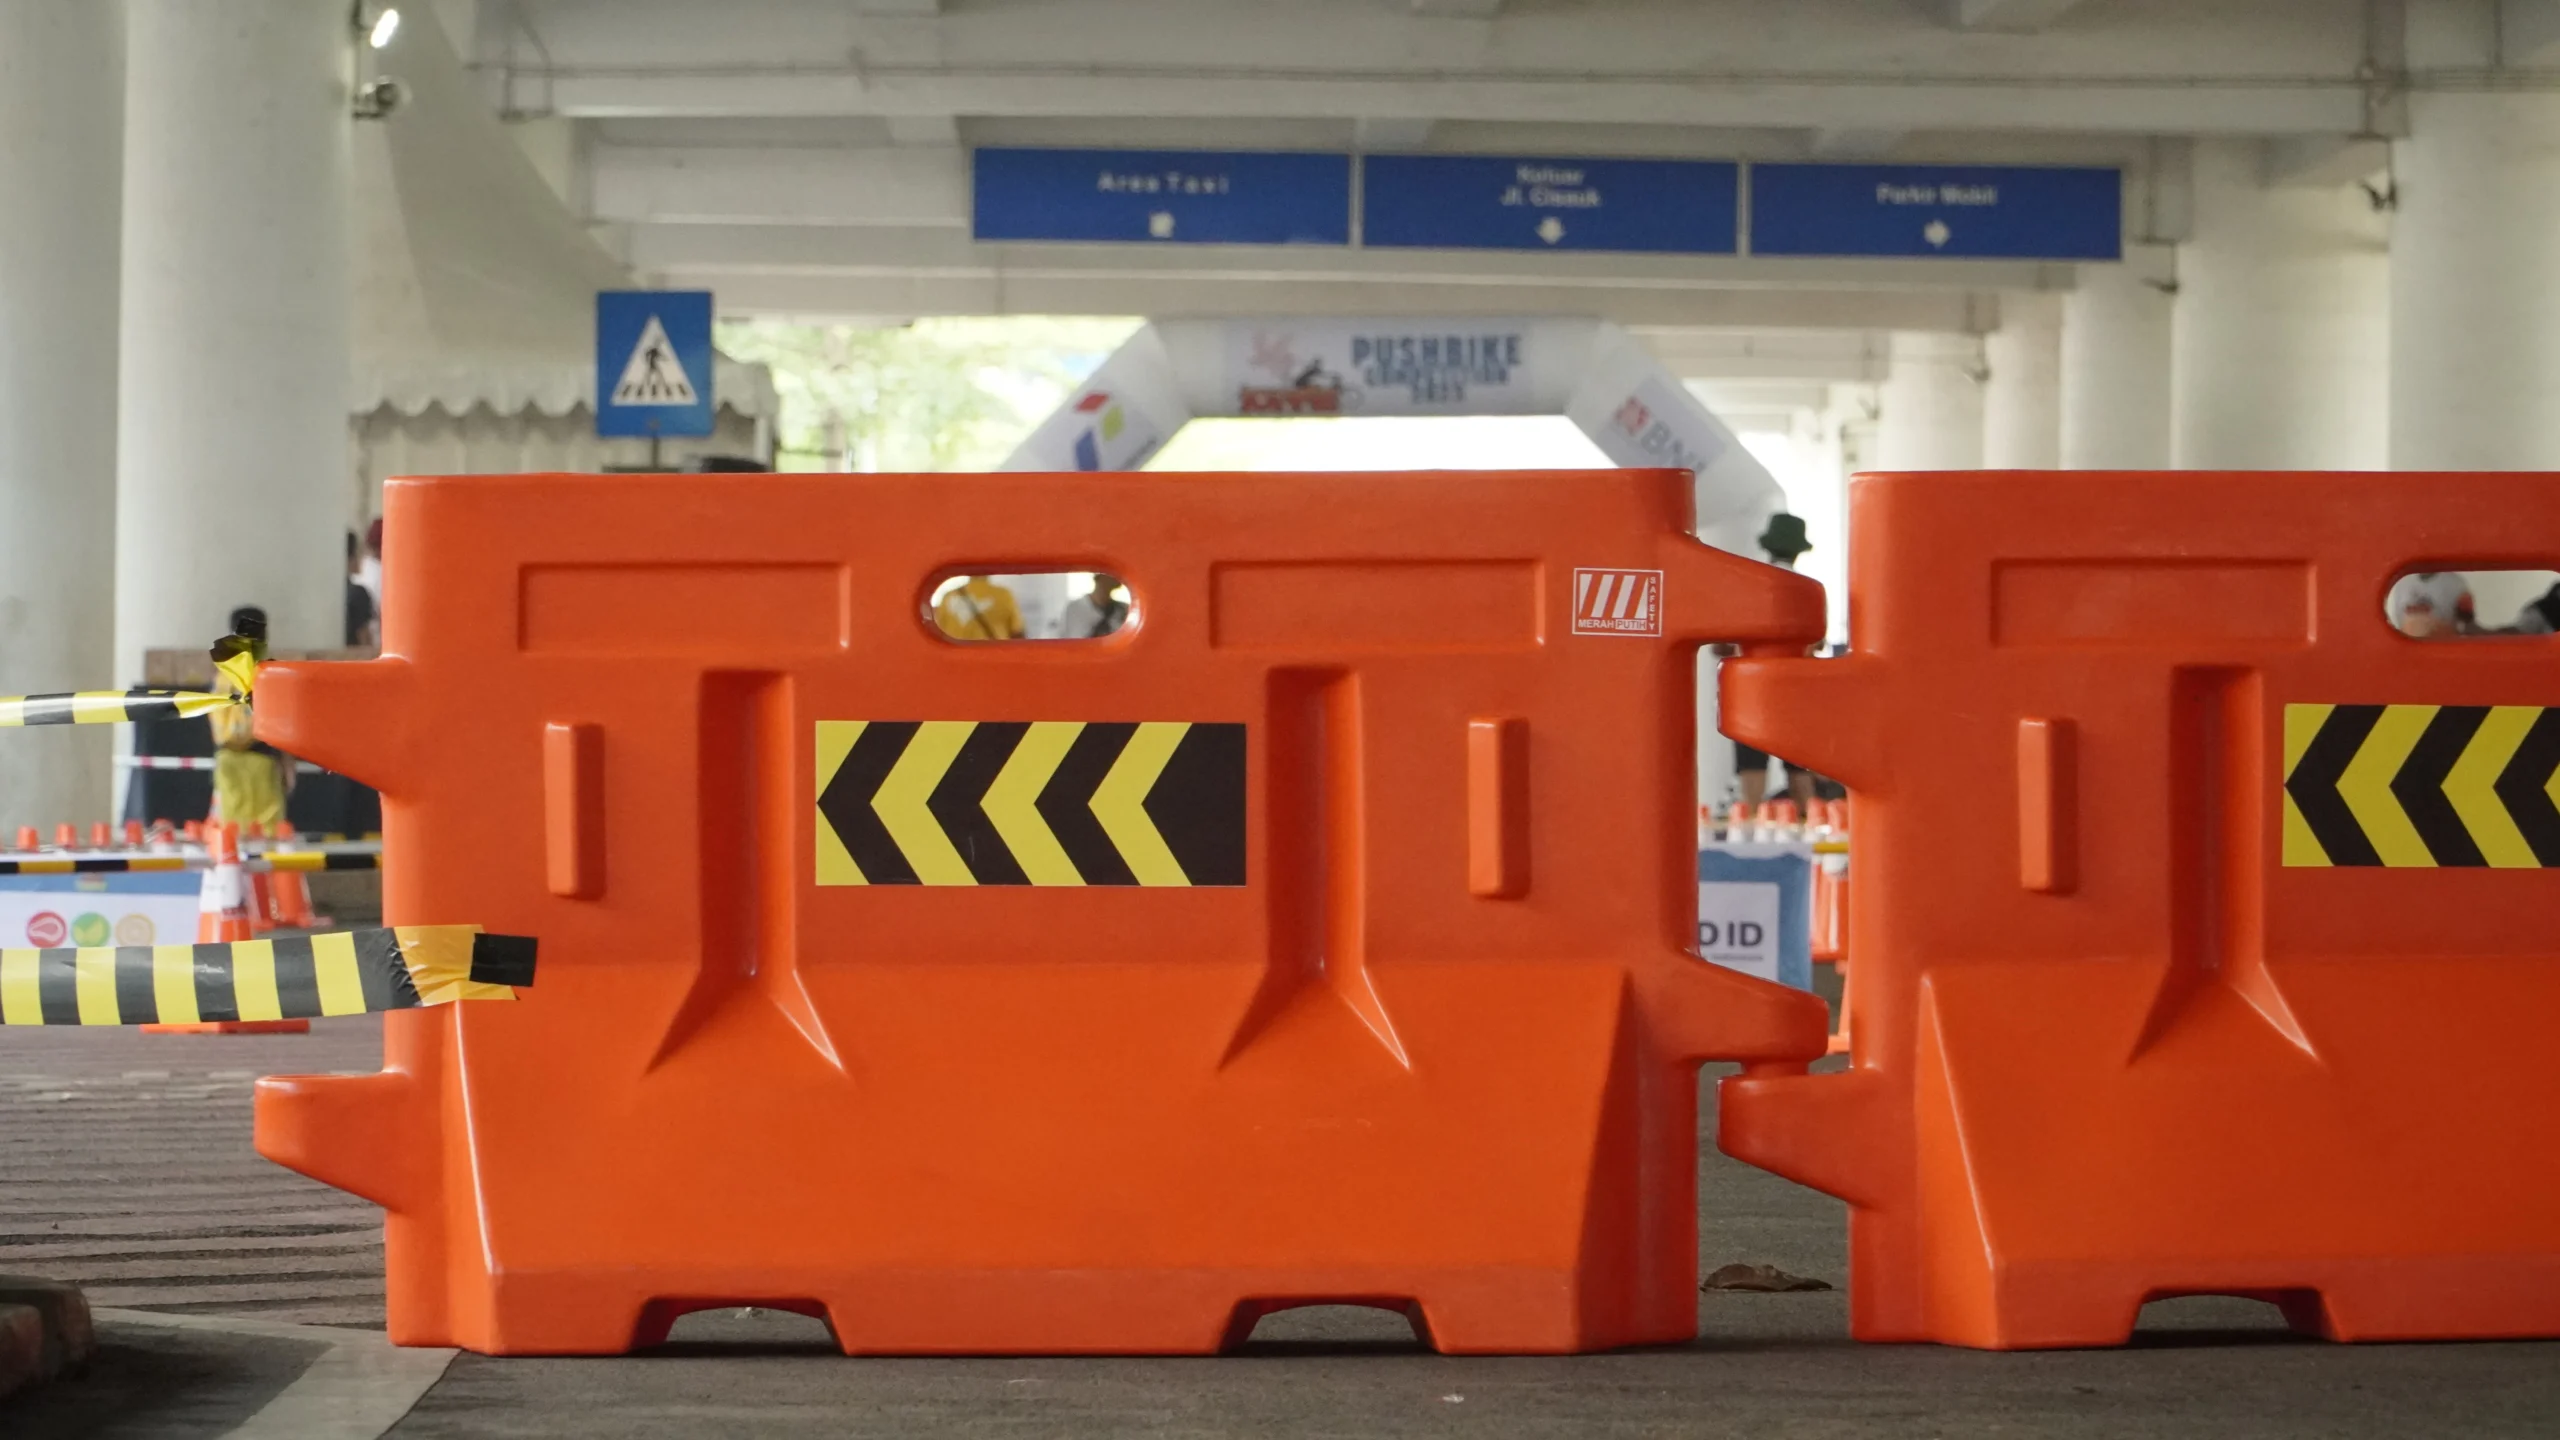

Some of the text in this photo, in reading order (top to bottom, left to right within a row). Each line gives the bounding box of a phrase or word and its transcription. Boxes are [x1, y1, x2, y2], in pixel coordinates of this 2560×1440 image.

[1352, 335, 1520, 366] PUSHBIKE
[1648, 577, 1657, 630] SAFETY
[1578, 619, 1647, 630] MERAH PUTIH
[1727, 922, 1762, 946] ID
